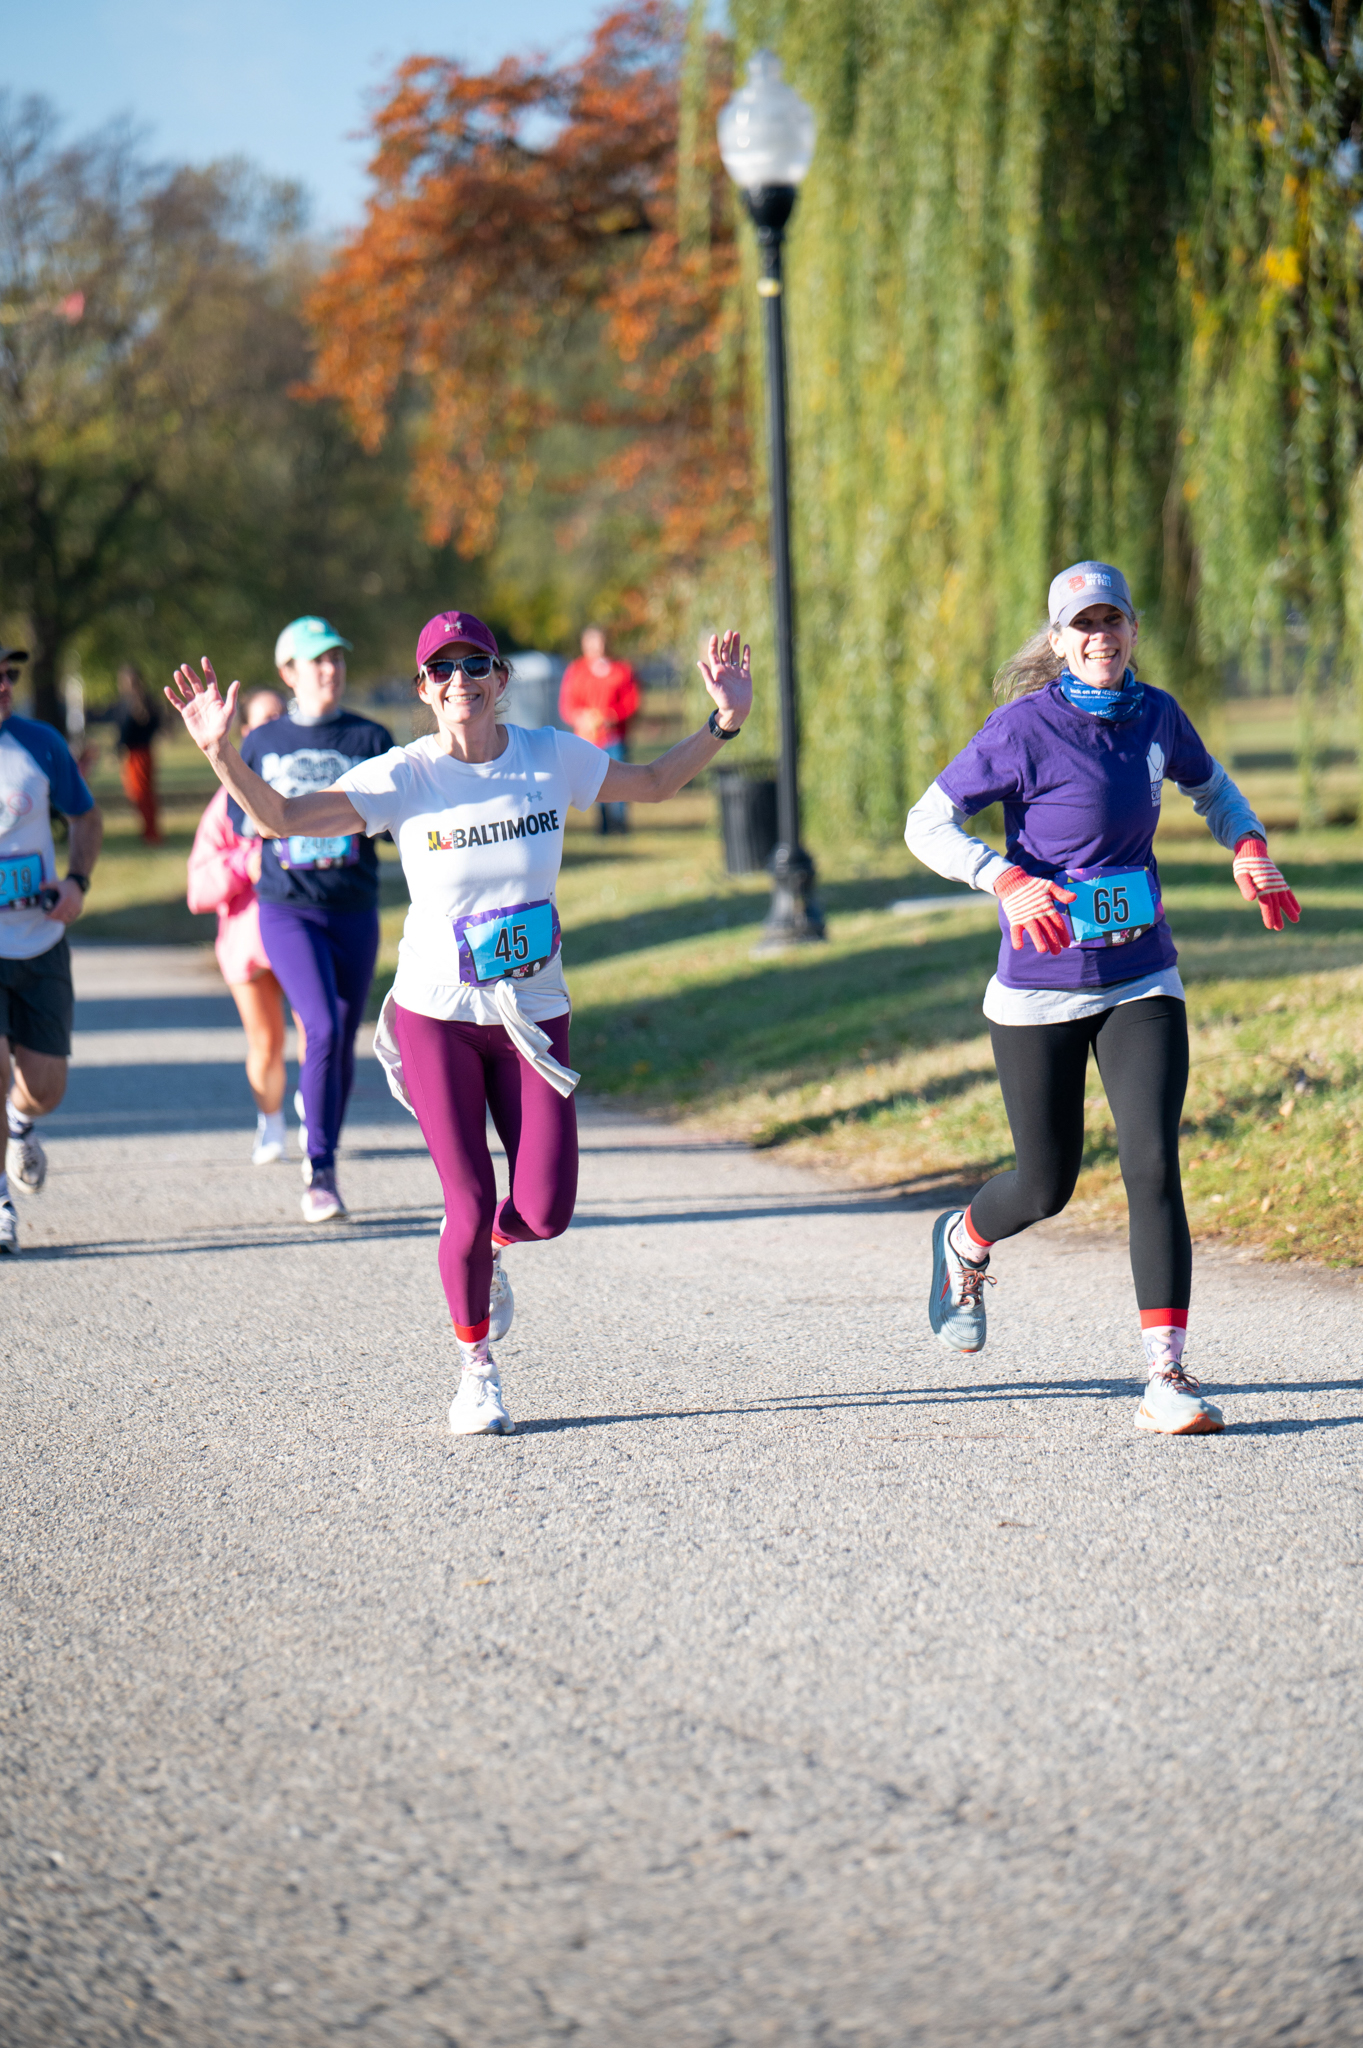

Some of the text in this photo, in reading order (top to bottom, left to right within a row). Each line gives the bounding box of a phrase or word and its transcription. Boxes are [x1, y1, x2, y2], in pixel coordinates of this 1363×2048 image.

[1085, 572, 1103, 580] BACK
[453, 809, 560, 849] BALTIMORE
[1093, 886, 1130, 926] 65
[494, 924, 529, 963] 45
